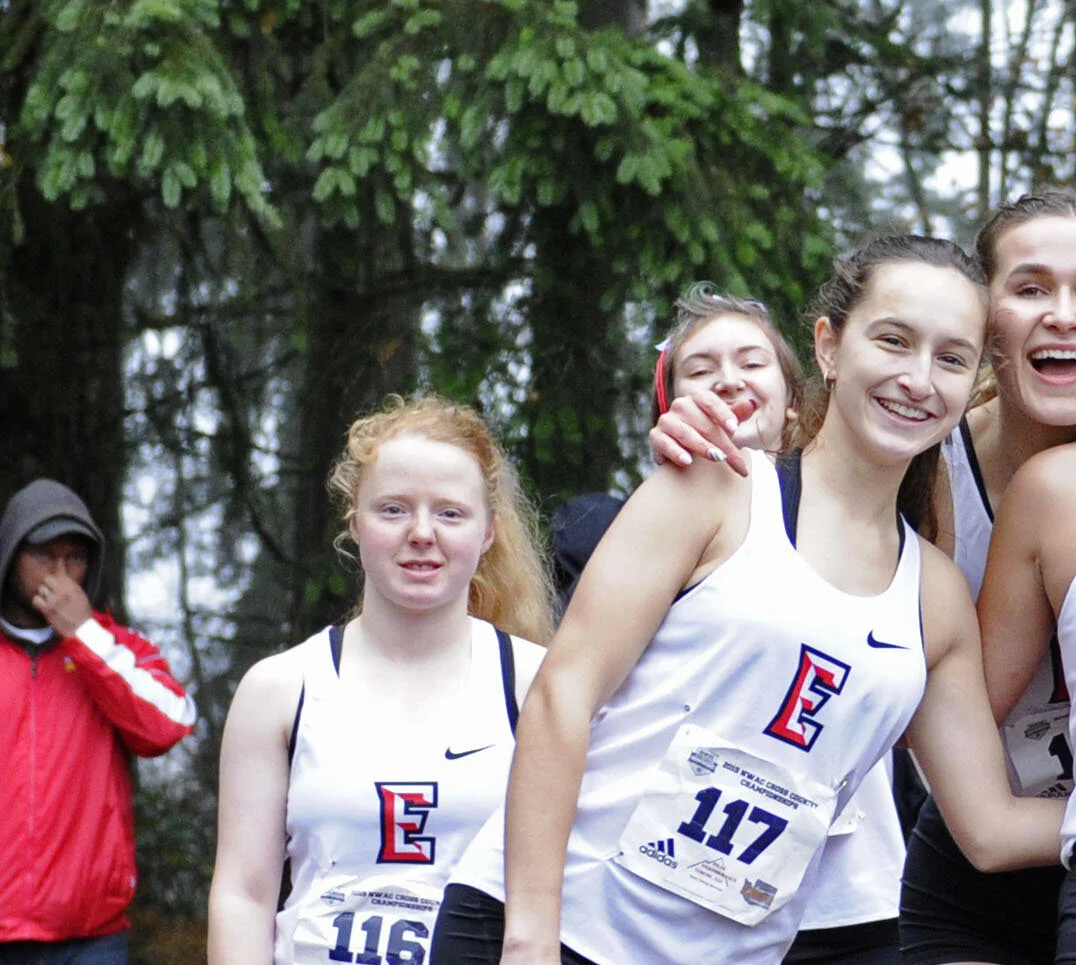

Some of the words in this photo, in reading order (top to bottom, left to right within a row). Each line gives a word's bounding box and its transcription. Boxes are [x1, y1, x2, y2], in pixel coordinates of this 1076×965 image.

[762, 642, 852, 753] E
[740, 778, 799, 810] CHAMPIONSHIPS
[765, 780, 790, 797] CROSS
[790, 792, 819, 809] COUNTRY
[374, 781, 438, 865] E
[677, 786, 789, 865] 117
[639, 845, 679, 870] adidas
